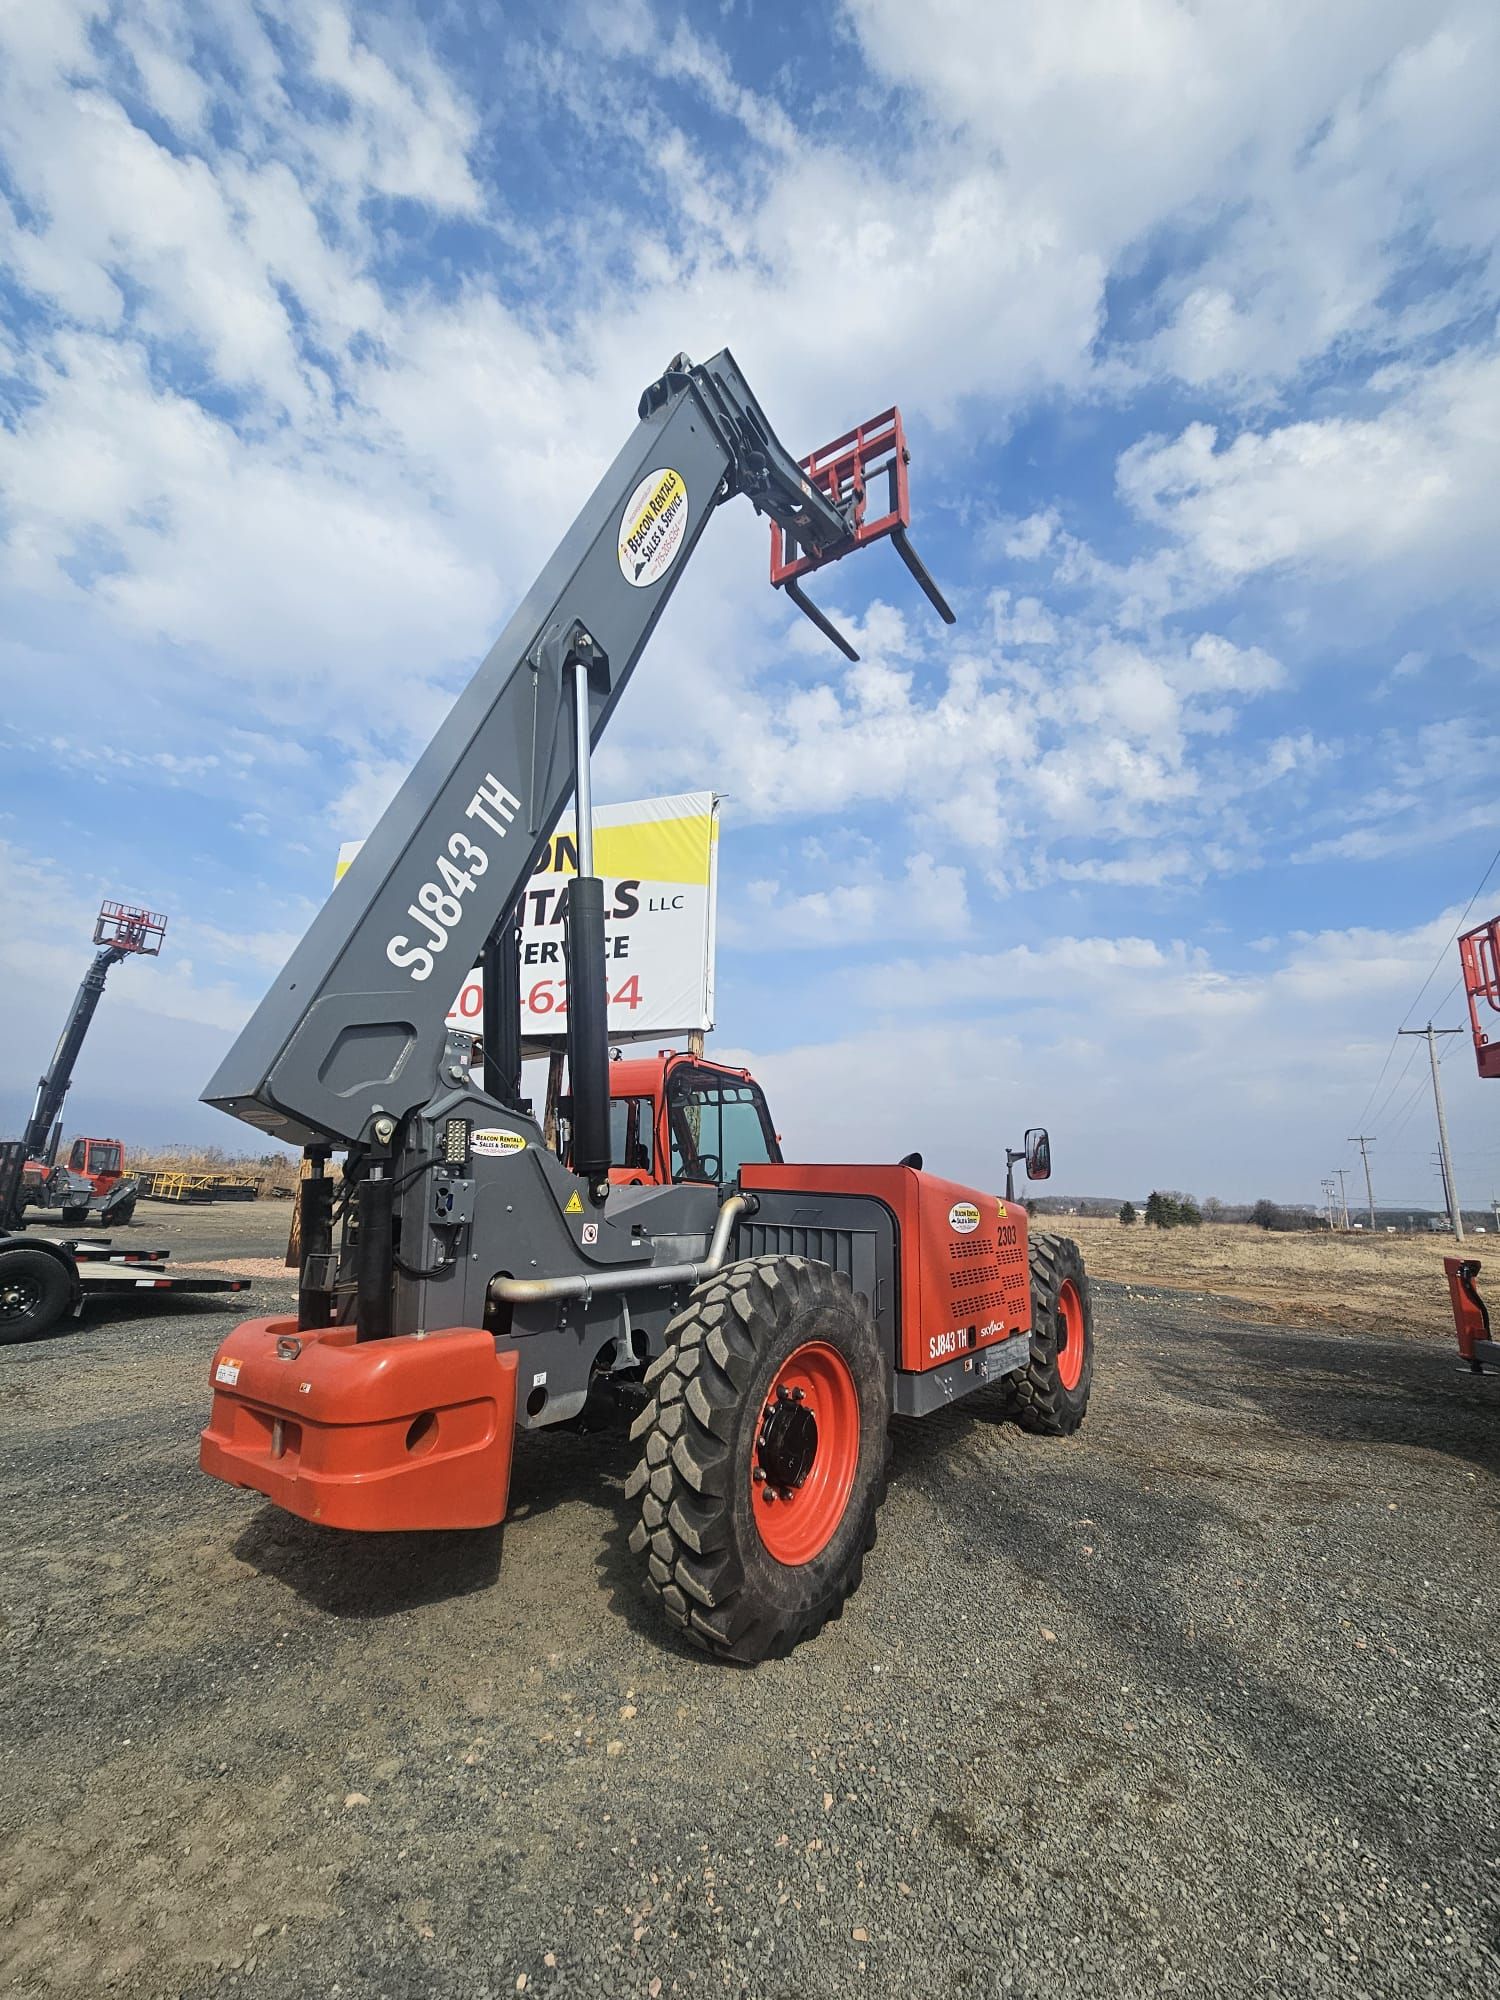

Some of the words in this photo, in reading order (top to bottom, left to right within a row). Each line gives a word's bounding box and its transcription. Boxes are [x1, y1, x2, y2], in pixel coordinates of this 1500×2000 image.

[627, 511, 654, 554] BEACON
[650, 472, 677, 516] RENTALS
[660, 492, 683, 528] SERVICE
[657, 524, 666, 535] &
[641, 531, 662, 562] SALES
[386, 832, 489, 981] SJ843
[465, 772, 521, 837] TH
[649, 895, 684, 912] LLC
[997, 1226, 1017, 1247] 2303
[930, 1332, 956, 1359] SJ843
[957, 1328, 967, 1349] TH
[980, 1320, 1004, 1337] SKYJACK
